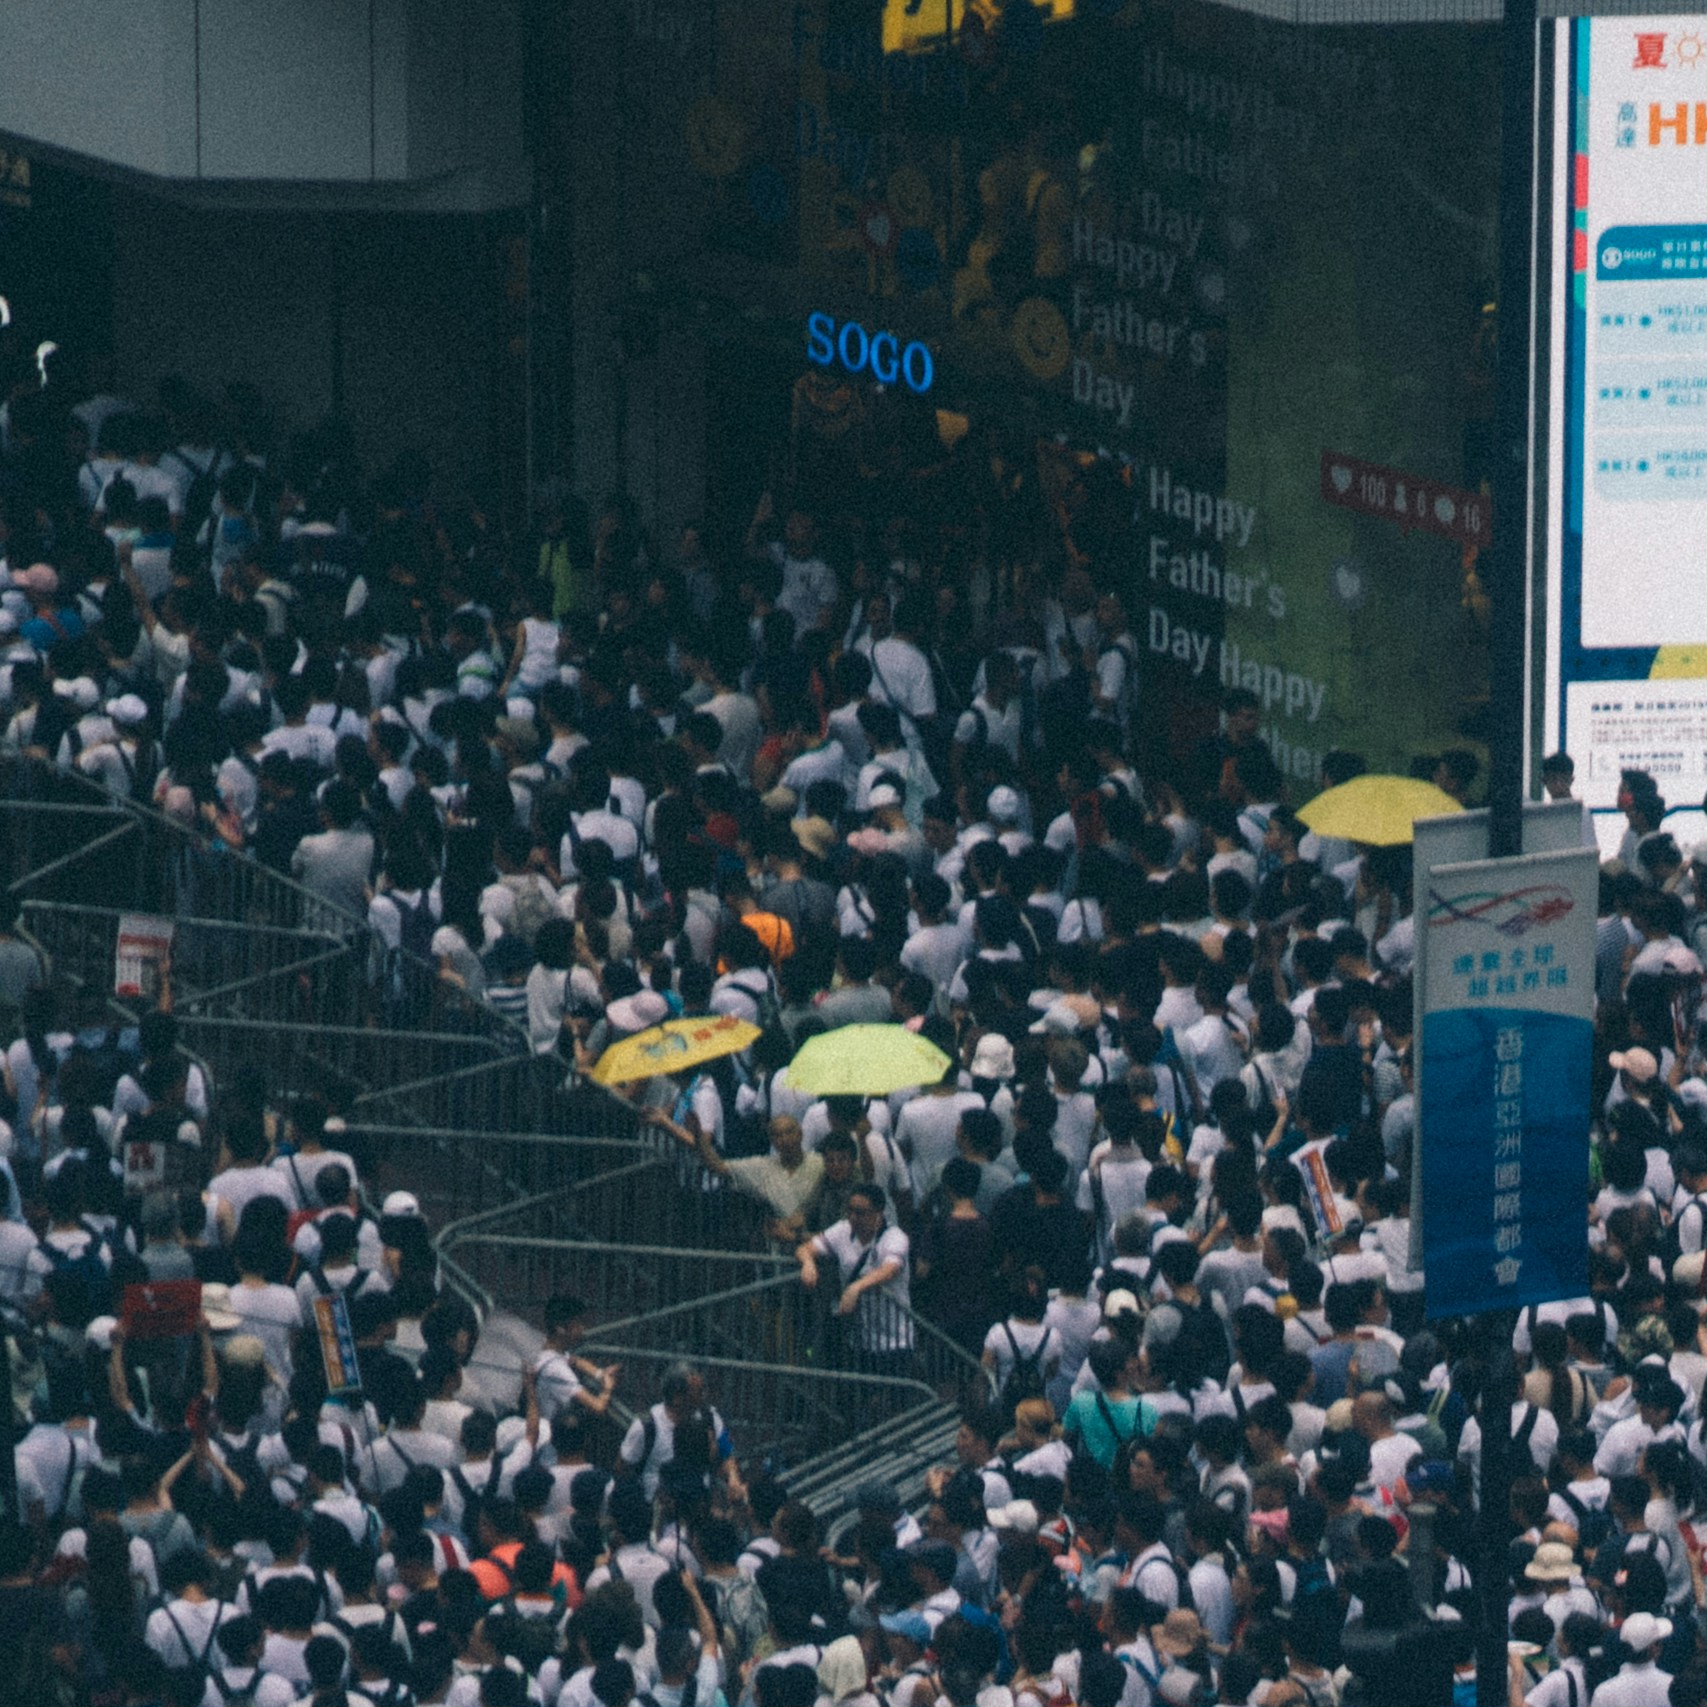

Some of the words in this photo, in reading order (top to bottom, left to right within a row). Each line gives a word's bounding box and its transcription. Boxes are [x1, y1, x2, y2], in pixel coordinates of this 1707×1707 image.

[1632, 32, 1669, 69] 夏
[1072, 214, 1178, 294] Happy
[806, 310, 935, 394] SOGO
[1072, 357, 1135, 428] Day
[1148, 465, 1257, 547] Happy
[1148, 535, 1287, 620] Father's
[1148, 605, 1211, 676] Day
[1218, 639, 1327, 723] Happy
